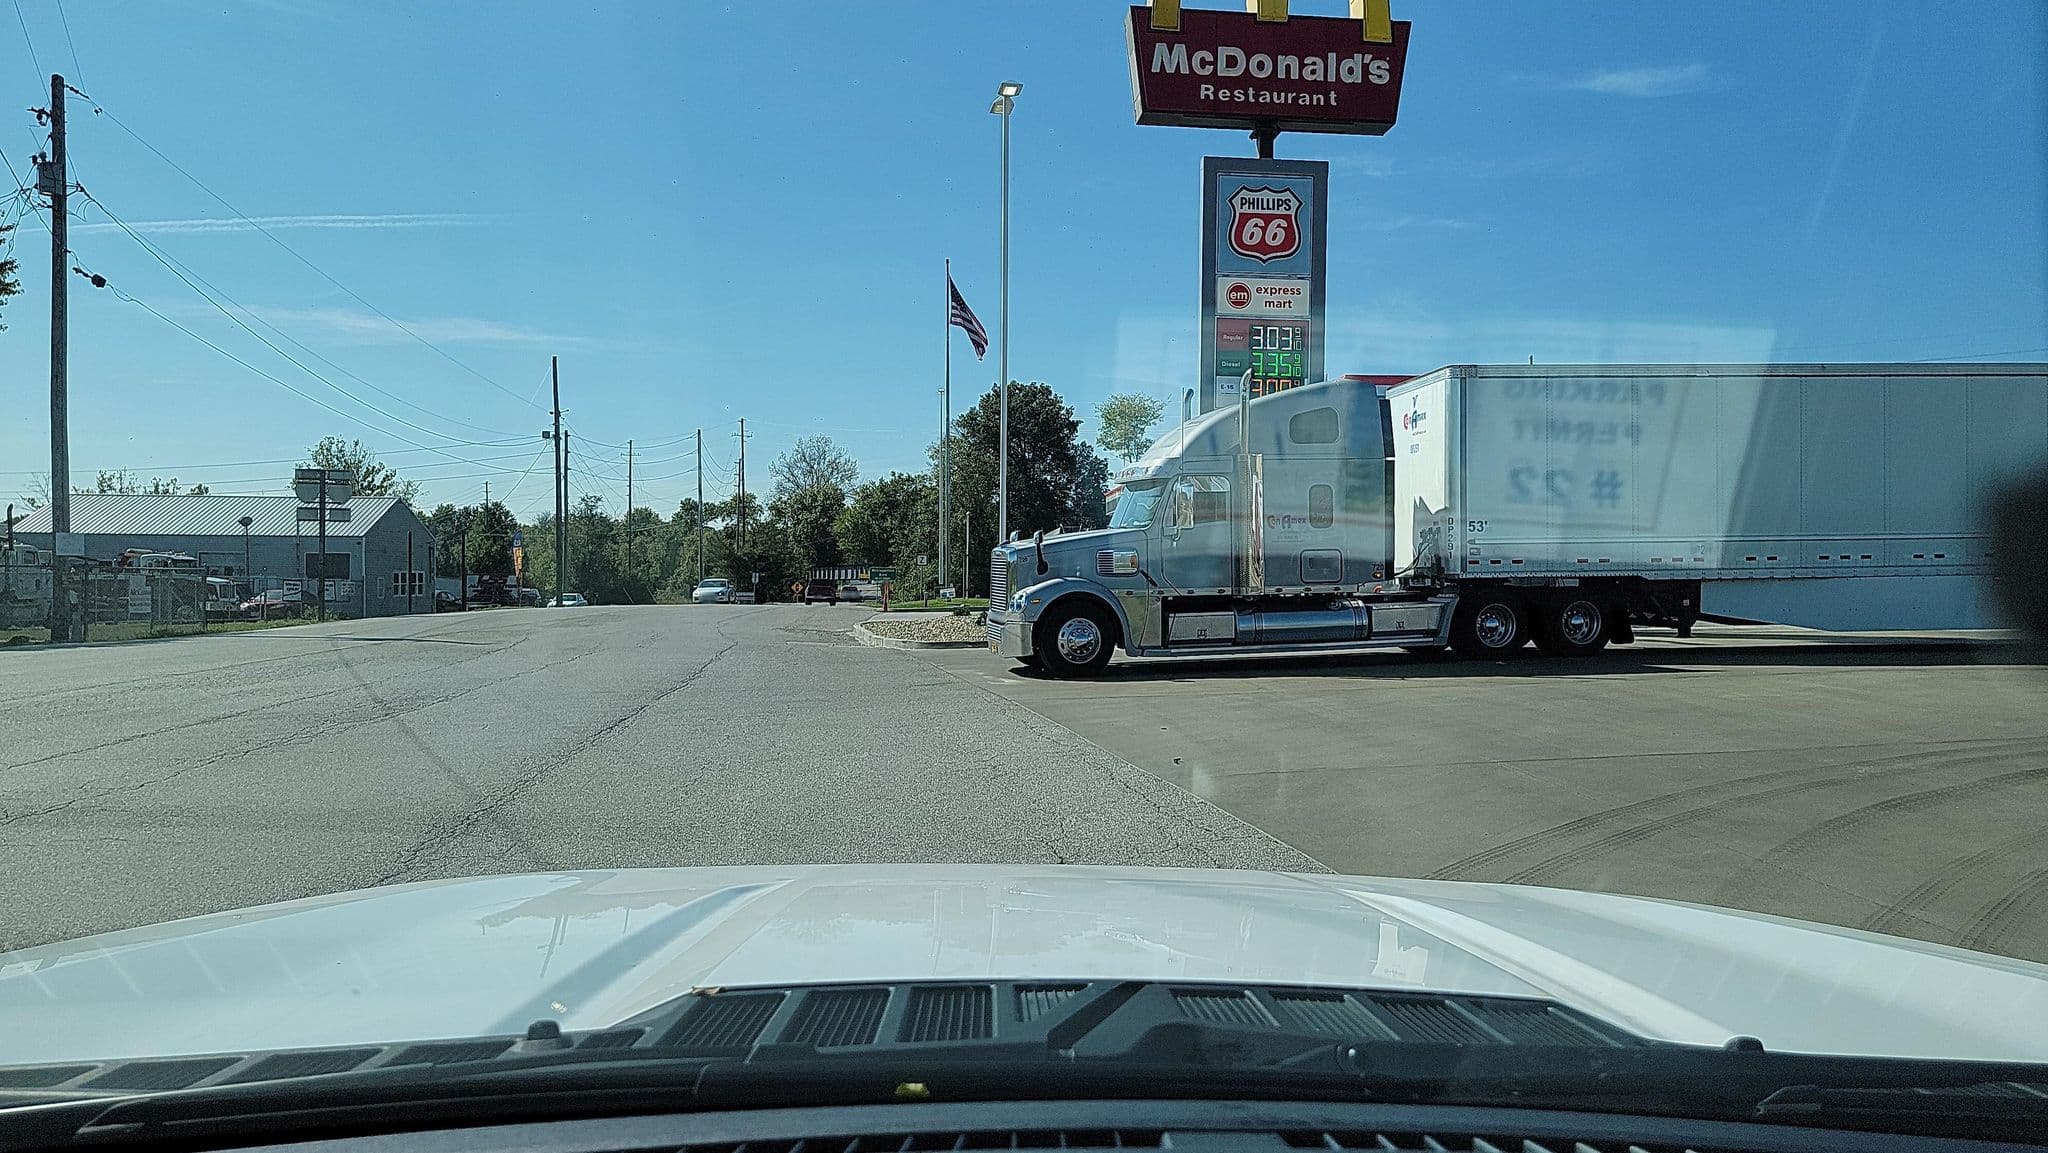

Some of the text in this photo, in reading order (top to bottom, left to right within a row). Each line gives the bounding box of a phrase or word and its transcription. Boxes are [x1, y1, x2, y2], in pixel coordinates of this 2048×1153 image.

[1150, 42, 1390, 84] McDonald's
[1200, 84, 1337, 106] Restaurant
[1239, 196, 1292, 212] PHILLIPS
[1242, 217, 1288, 247] 66
[1230, 291, 1248, 300] em
[1255, 286, 1302, 296] express
[1264, 299, 1293, 308] mart
[1252, 326, 1292, 350] 3.03
[1252, 352, 1292, 376] 3.35
